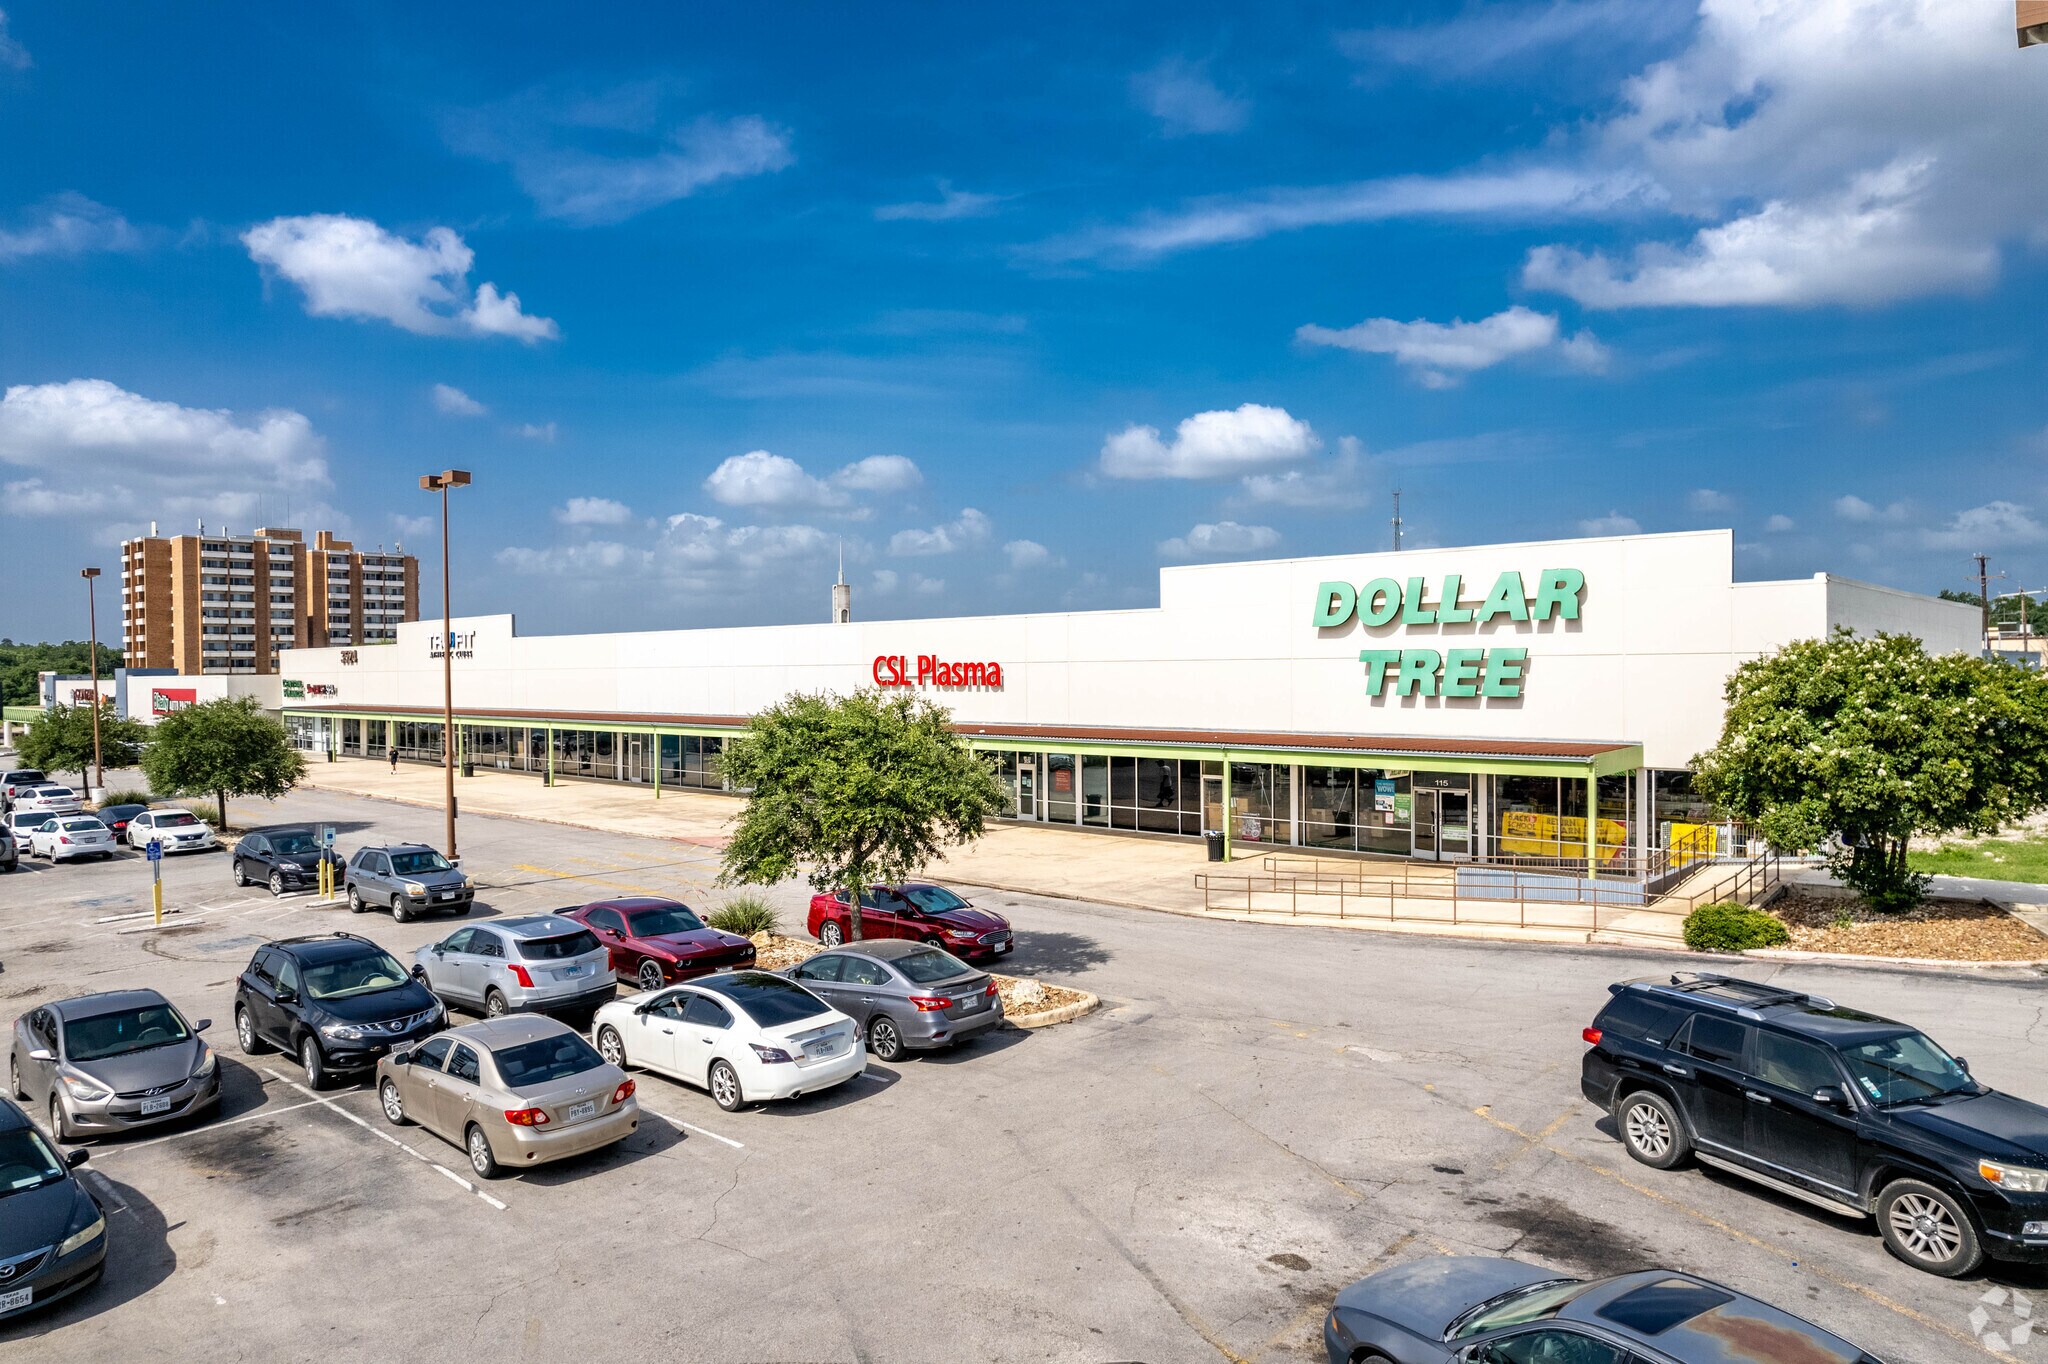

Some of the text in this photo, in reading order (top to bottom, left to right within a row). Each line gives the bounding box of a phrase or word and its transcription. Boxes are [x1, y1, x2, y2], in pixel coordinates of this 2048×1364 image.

[1312, 568, 1585, 627] DOLLAR
[873, 655, 1001, 686] CSL Plasma
[1359, 647, 1528, 697] TREE
[1435, 779, 1449, 787] 115
[1507, 821, 1536, 830] SCHOOL
[1551, 826, 1581, 835] LARN
[0, 1293, 29, 1309] R-8654
